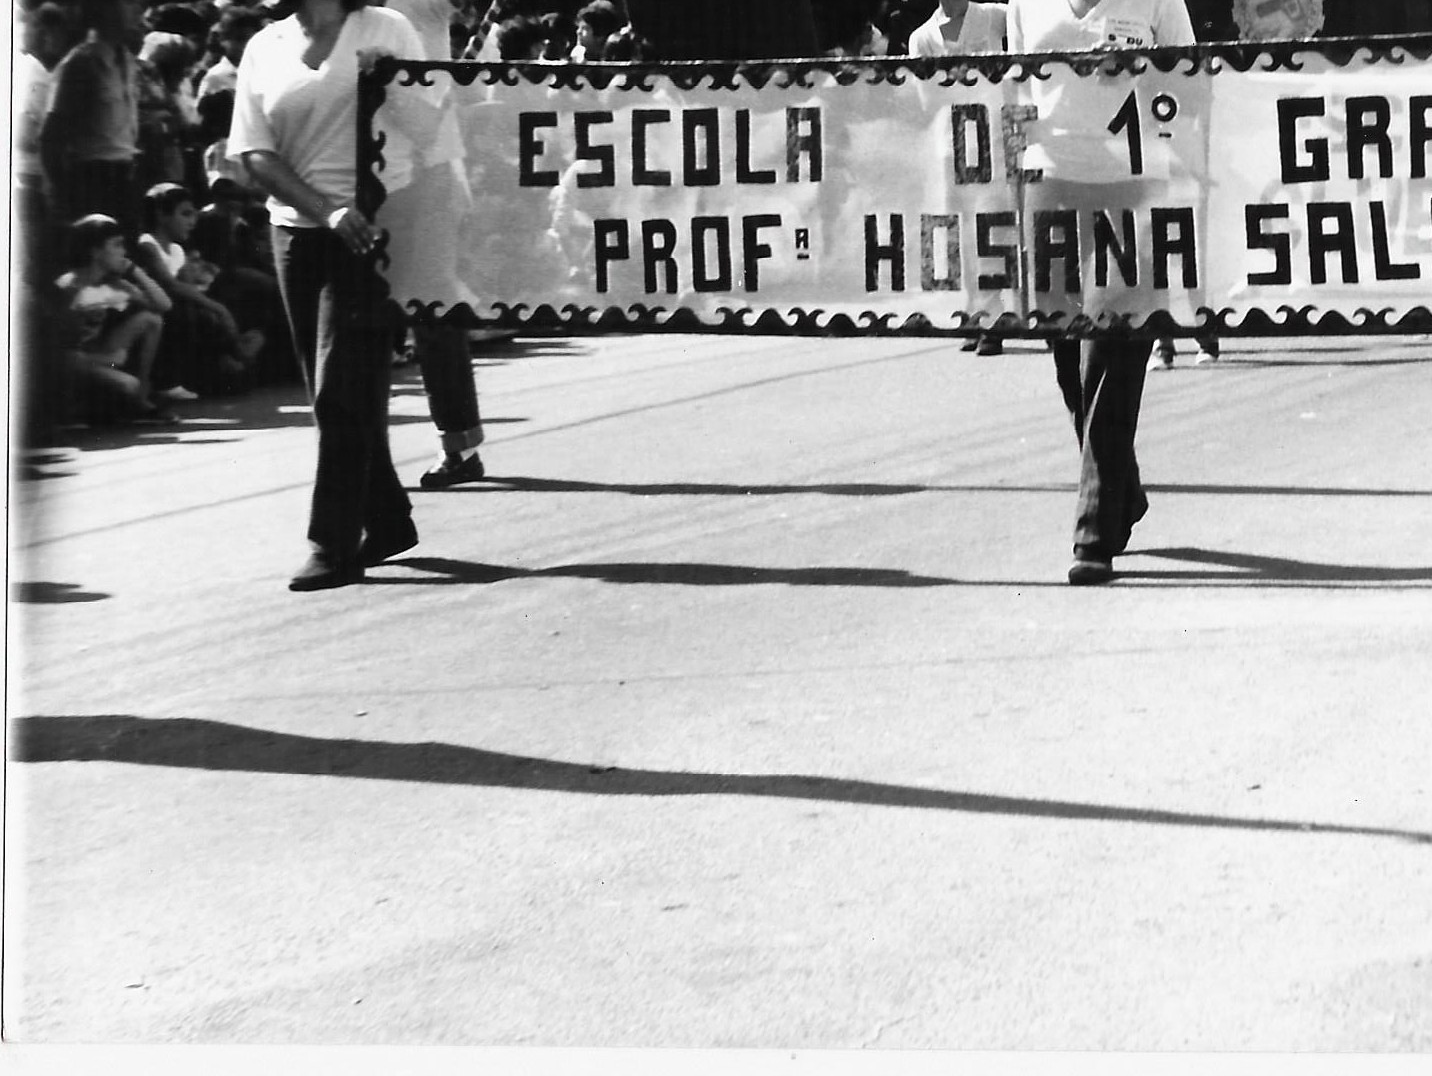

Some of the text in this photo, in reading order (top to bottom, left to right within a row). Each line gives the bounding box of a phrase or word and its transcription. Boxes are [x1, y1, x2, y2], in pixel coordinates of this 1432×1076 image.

[518, 106, 823, 187] ESCOLA
[950, 103, 1044, 186] DE
[863, 207, 1199, 292] HOSANA
